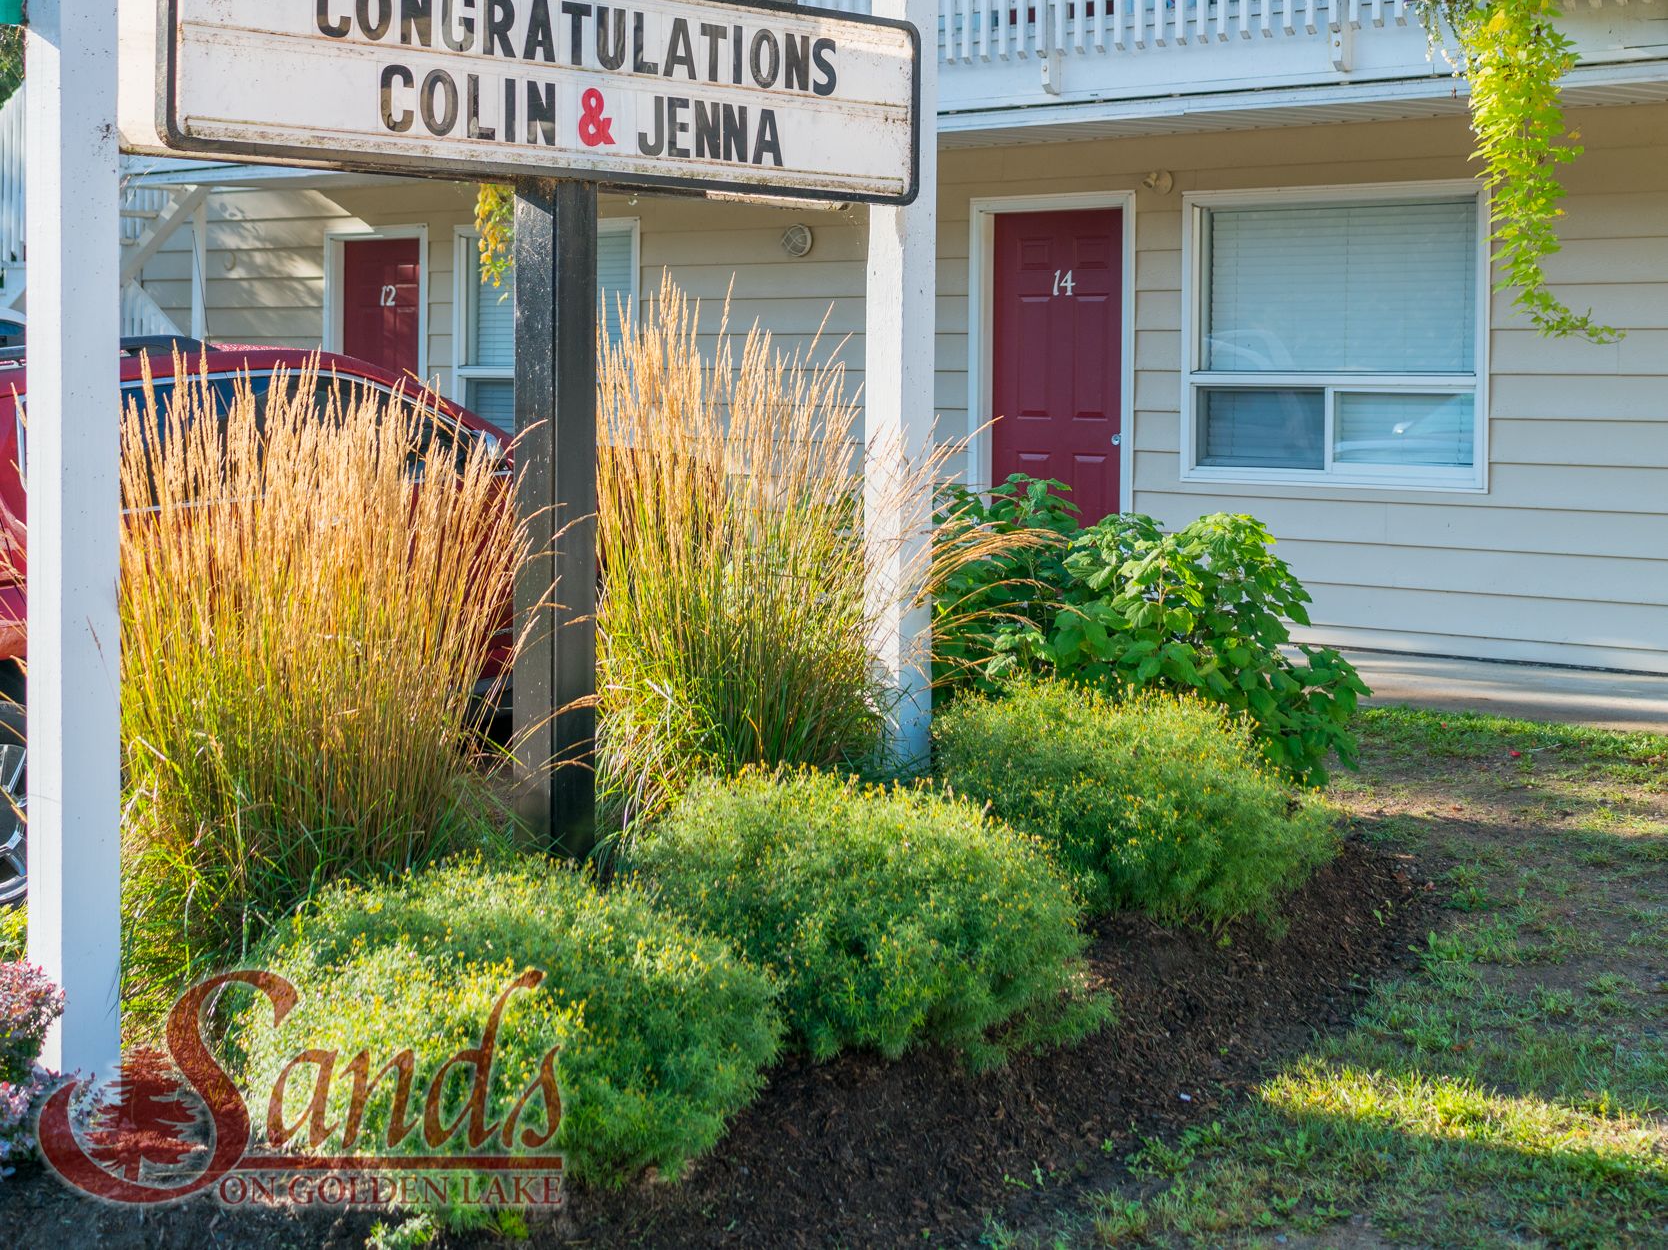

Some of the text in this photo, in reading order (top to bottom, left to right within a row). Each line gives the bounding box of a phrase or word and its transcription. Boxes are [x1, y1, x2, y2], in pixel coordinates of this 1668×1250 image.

[380, 65, 783, 167] COLIN & JENNA
[380, 285, 396, 306] 12
[1053, 269, 1076, 296] 14
